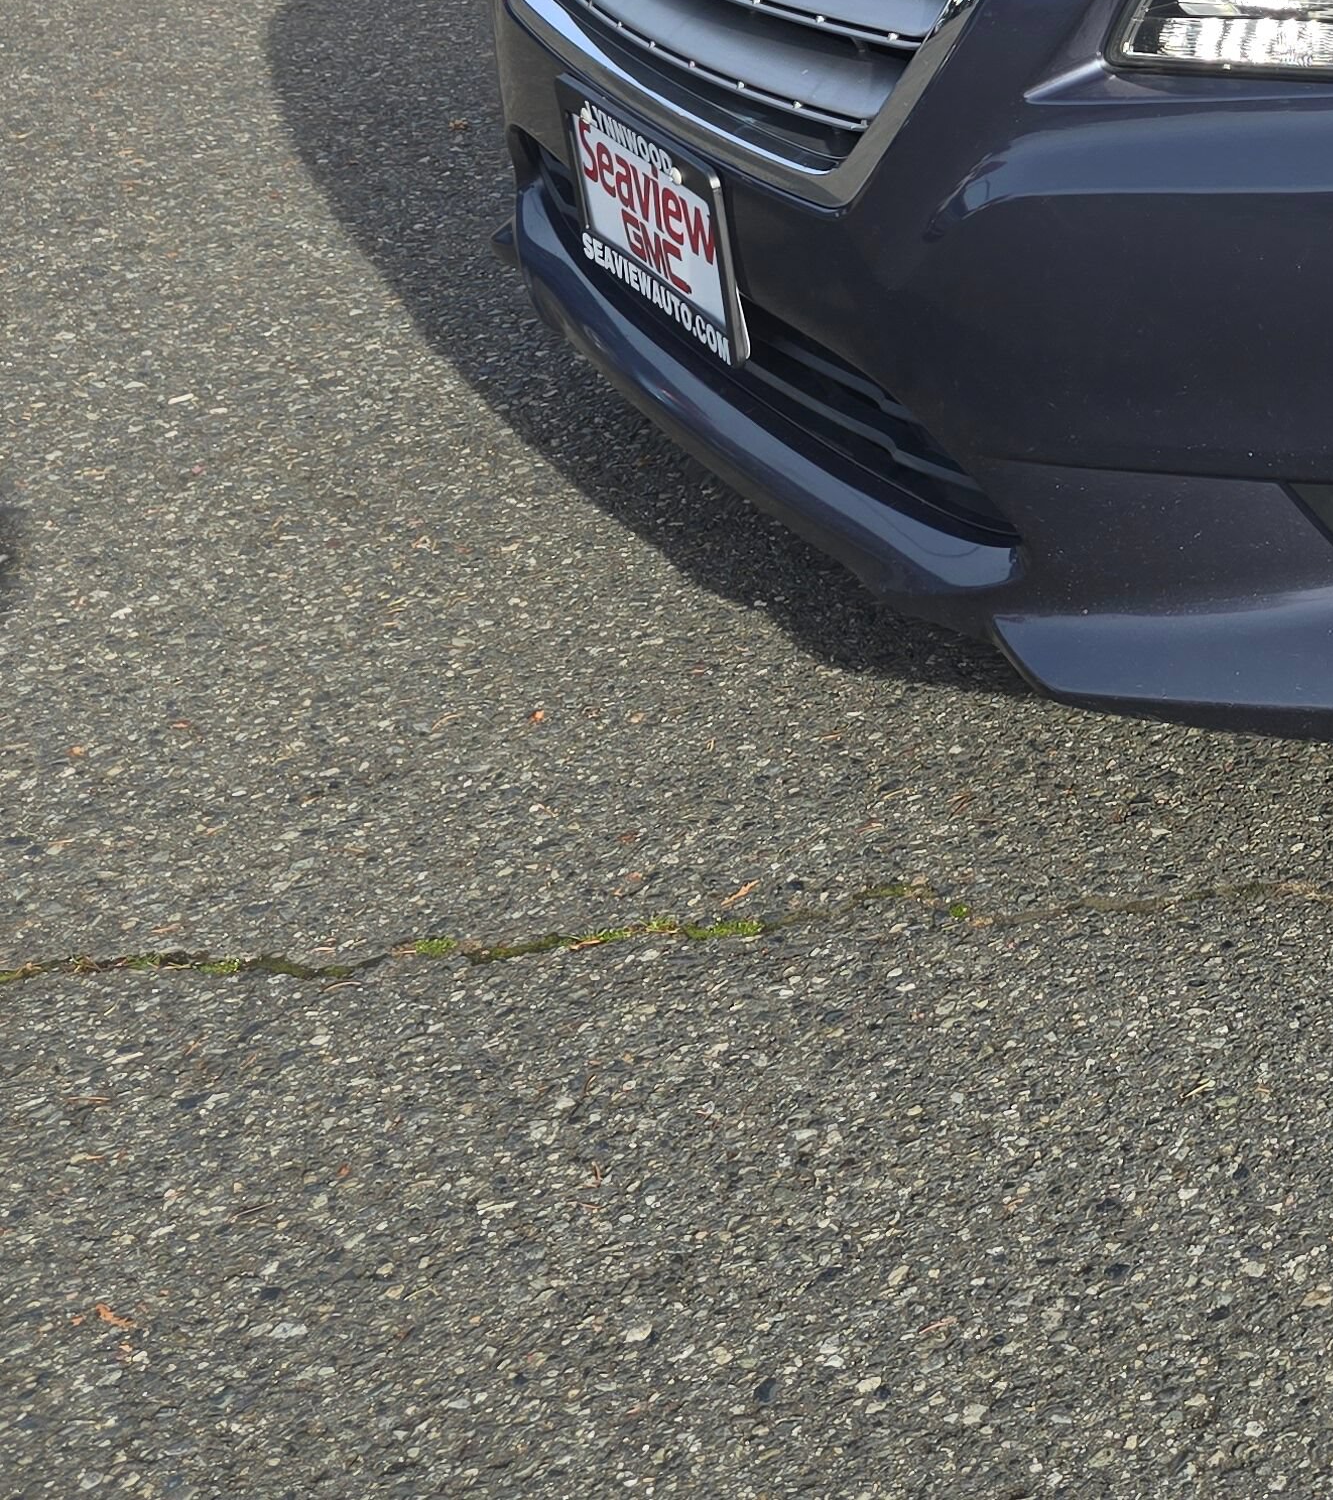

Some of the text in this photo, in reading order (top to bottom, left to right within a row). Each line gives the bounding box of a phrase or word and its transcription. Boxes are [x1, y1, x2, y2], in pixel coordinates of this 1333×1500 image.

[578, 119, 716, 265] Seaview
[584, 100, 674, 175] LYNNWOOD
[582, 232, 732, 365] SEAVIEWAUTO.COM
[621, 208, 692, 294] GMC
